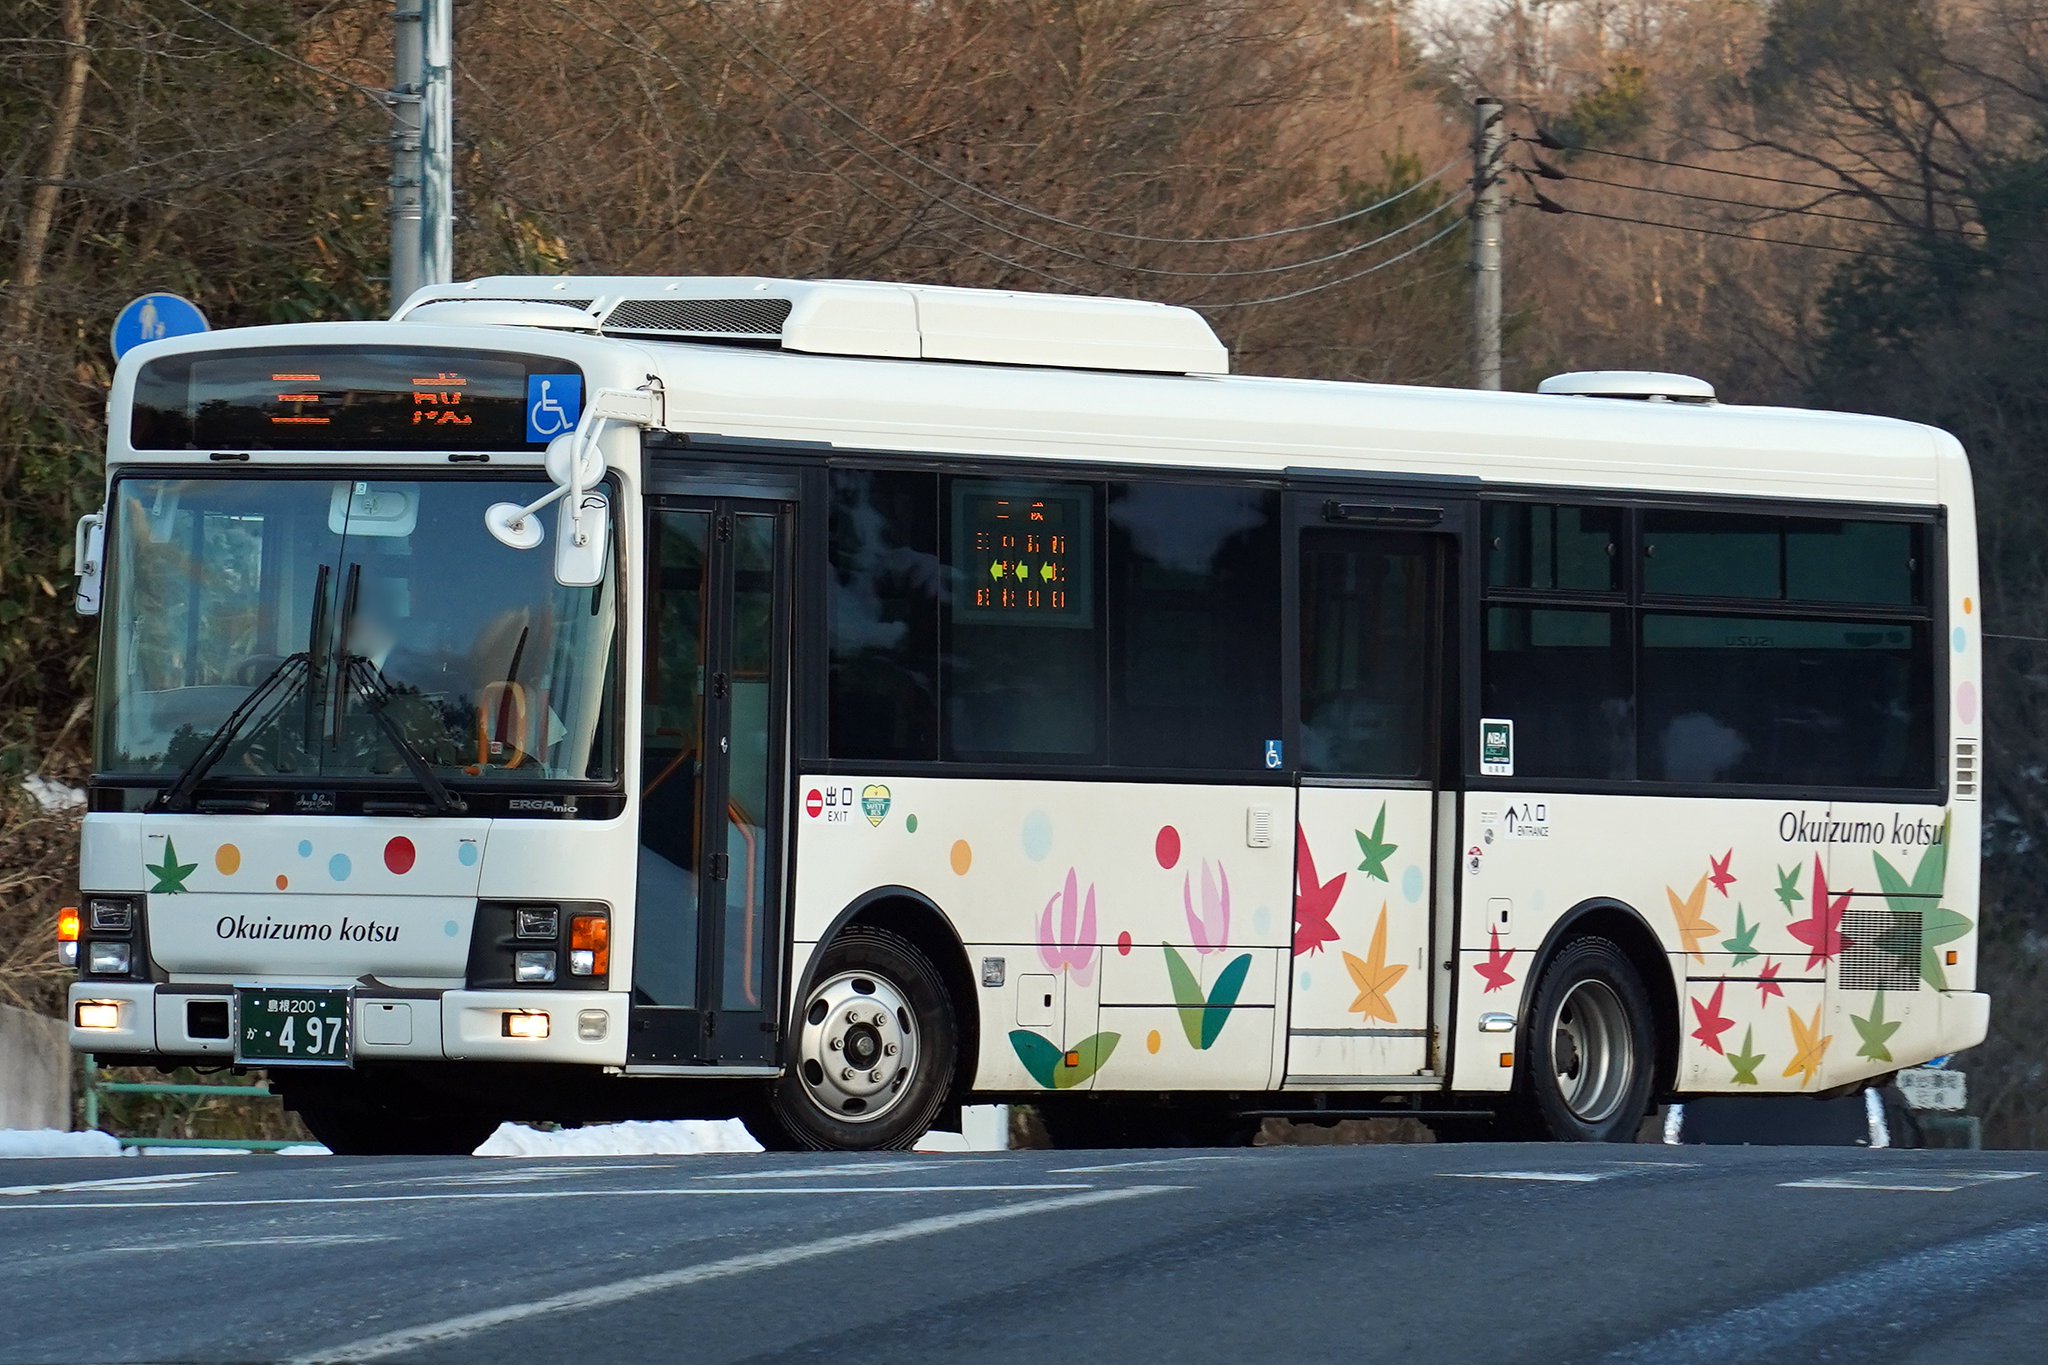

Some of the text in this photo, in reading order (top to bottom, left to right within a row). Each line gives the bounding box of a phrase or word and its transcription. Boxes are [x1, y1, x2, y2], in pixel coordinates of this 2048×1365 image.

[825, 786, 853, 806] 出口
[828, 810, 848, 822] EXIT
[1521, 803, 1546, 821] 入口
[1517, 825, 1549, 837] ENTRANCE
[1779, 810, 1945, 846] Okuizumo kotsu
[216, 915, 399, 942] Okuizumo kotsu
[246, 1027, 258, 1040] か
